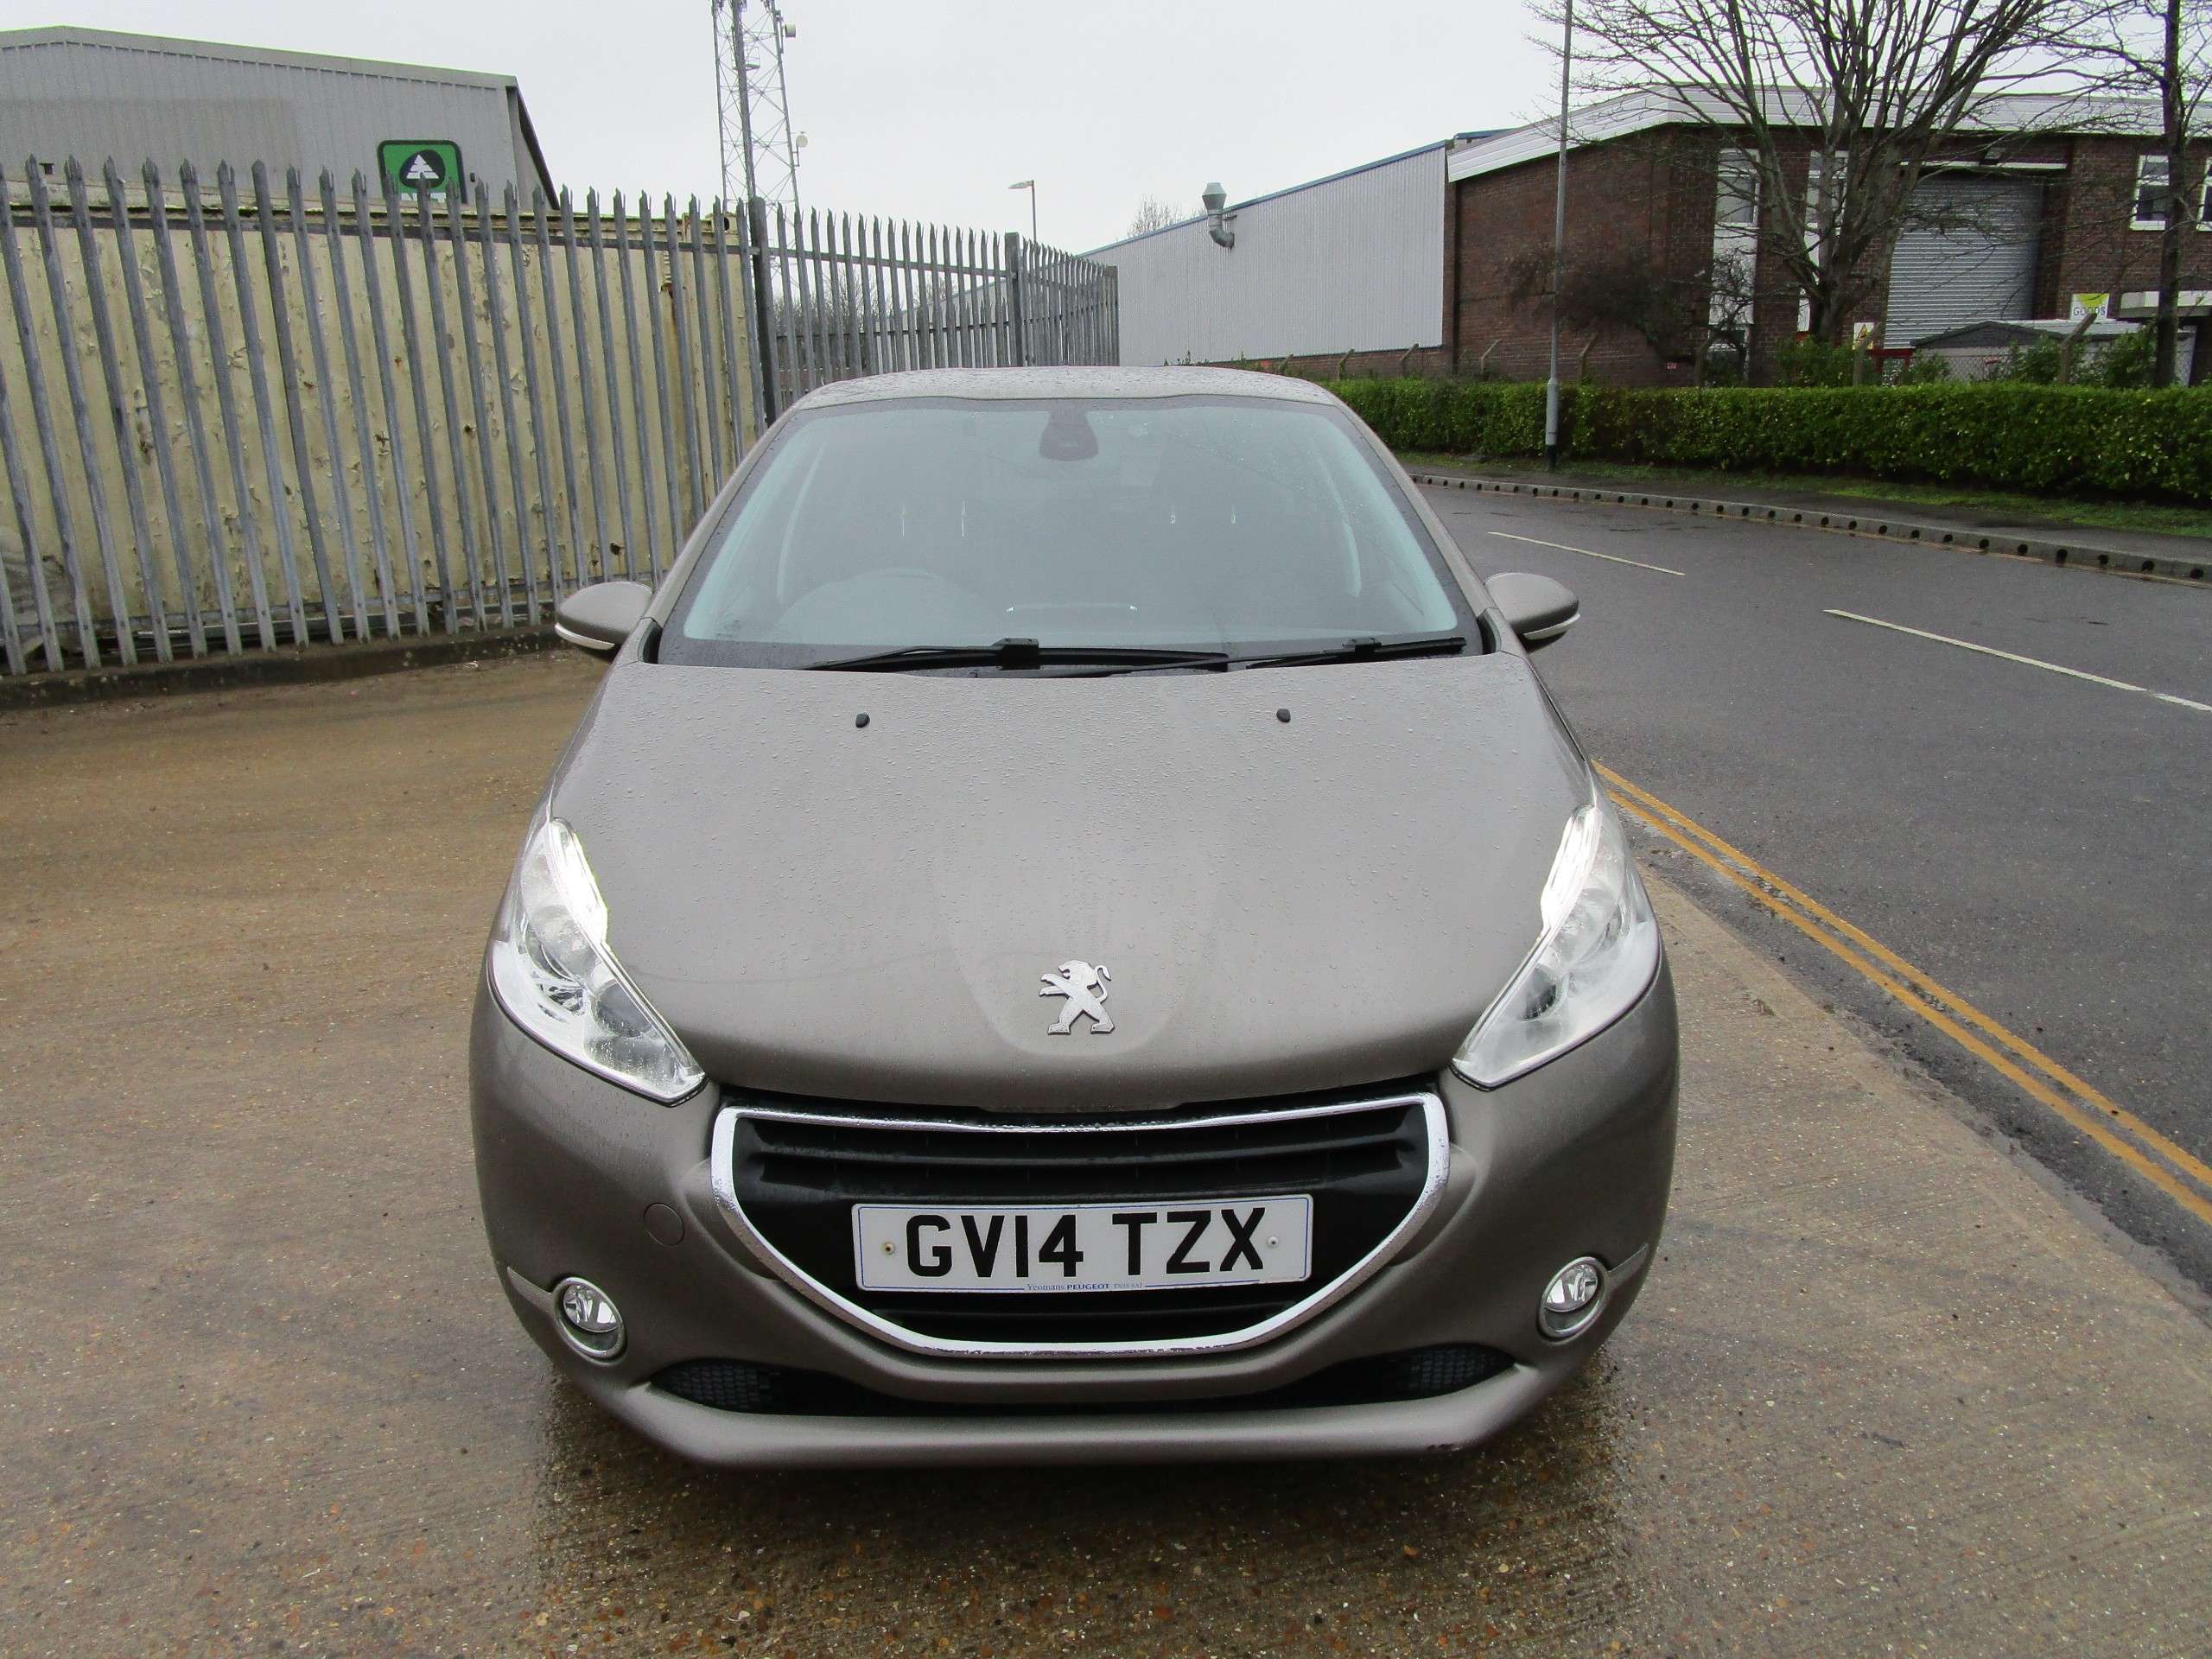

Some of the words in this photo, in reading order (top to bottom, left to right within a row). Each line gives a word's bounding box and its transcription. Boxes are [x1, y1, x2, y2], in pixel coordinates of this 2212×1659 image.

[2074, 306, 2106, 316] GOODS
[906, 1214, 1084, 1278] GV14
[1111, 1208, 1265, 1276] TZX
